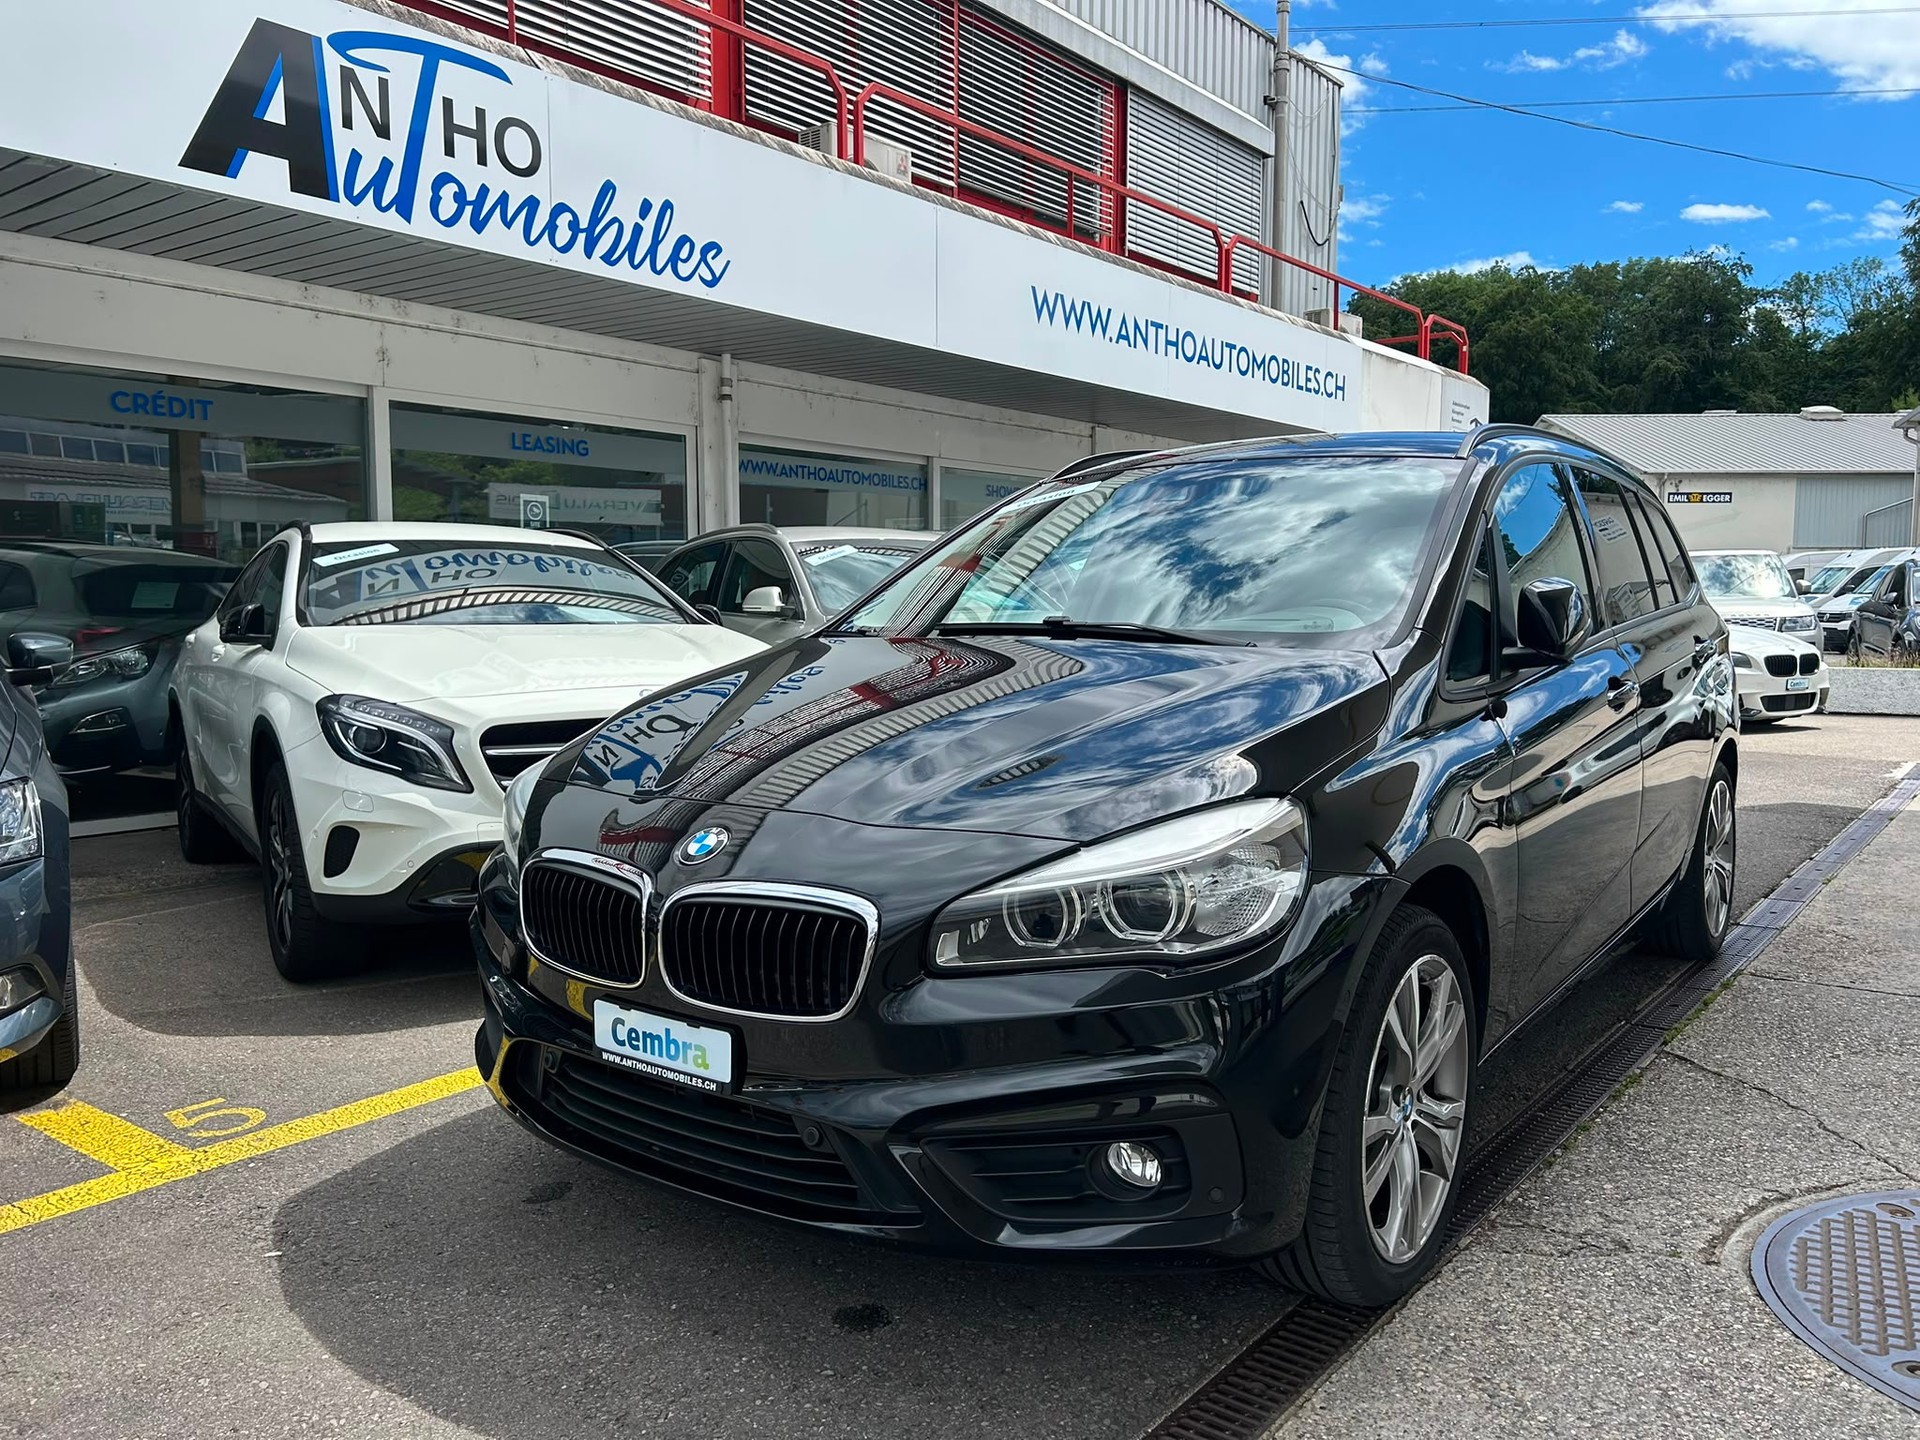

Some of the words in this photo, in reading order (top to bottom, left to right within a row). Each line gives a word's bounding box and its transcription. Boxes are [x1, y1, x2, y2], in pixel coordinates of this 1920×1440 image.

[1031, 285, 1346, 402] WWW.ANTHOAUTOMOBILES.CH
[111, 390, 214, 421] CRÉDIT
[512, 432, 590, 457] LEASING
[1670, 494, 1688, 502] EMIL
[1702, 494, 1731, 502] EGGER
[611, 1017, 710, 1071] Cembra
[602, 1051, 717, 1092] WWW.ANTHOAUTOMOBILES.CH
[163, 1097, 267, 1137] 5
